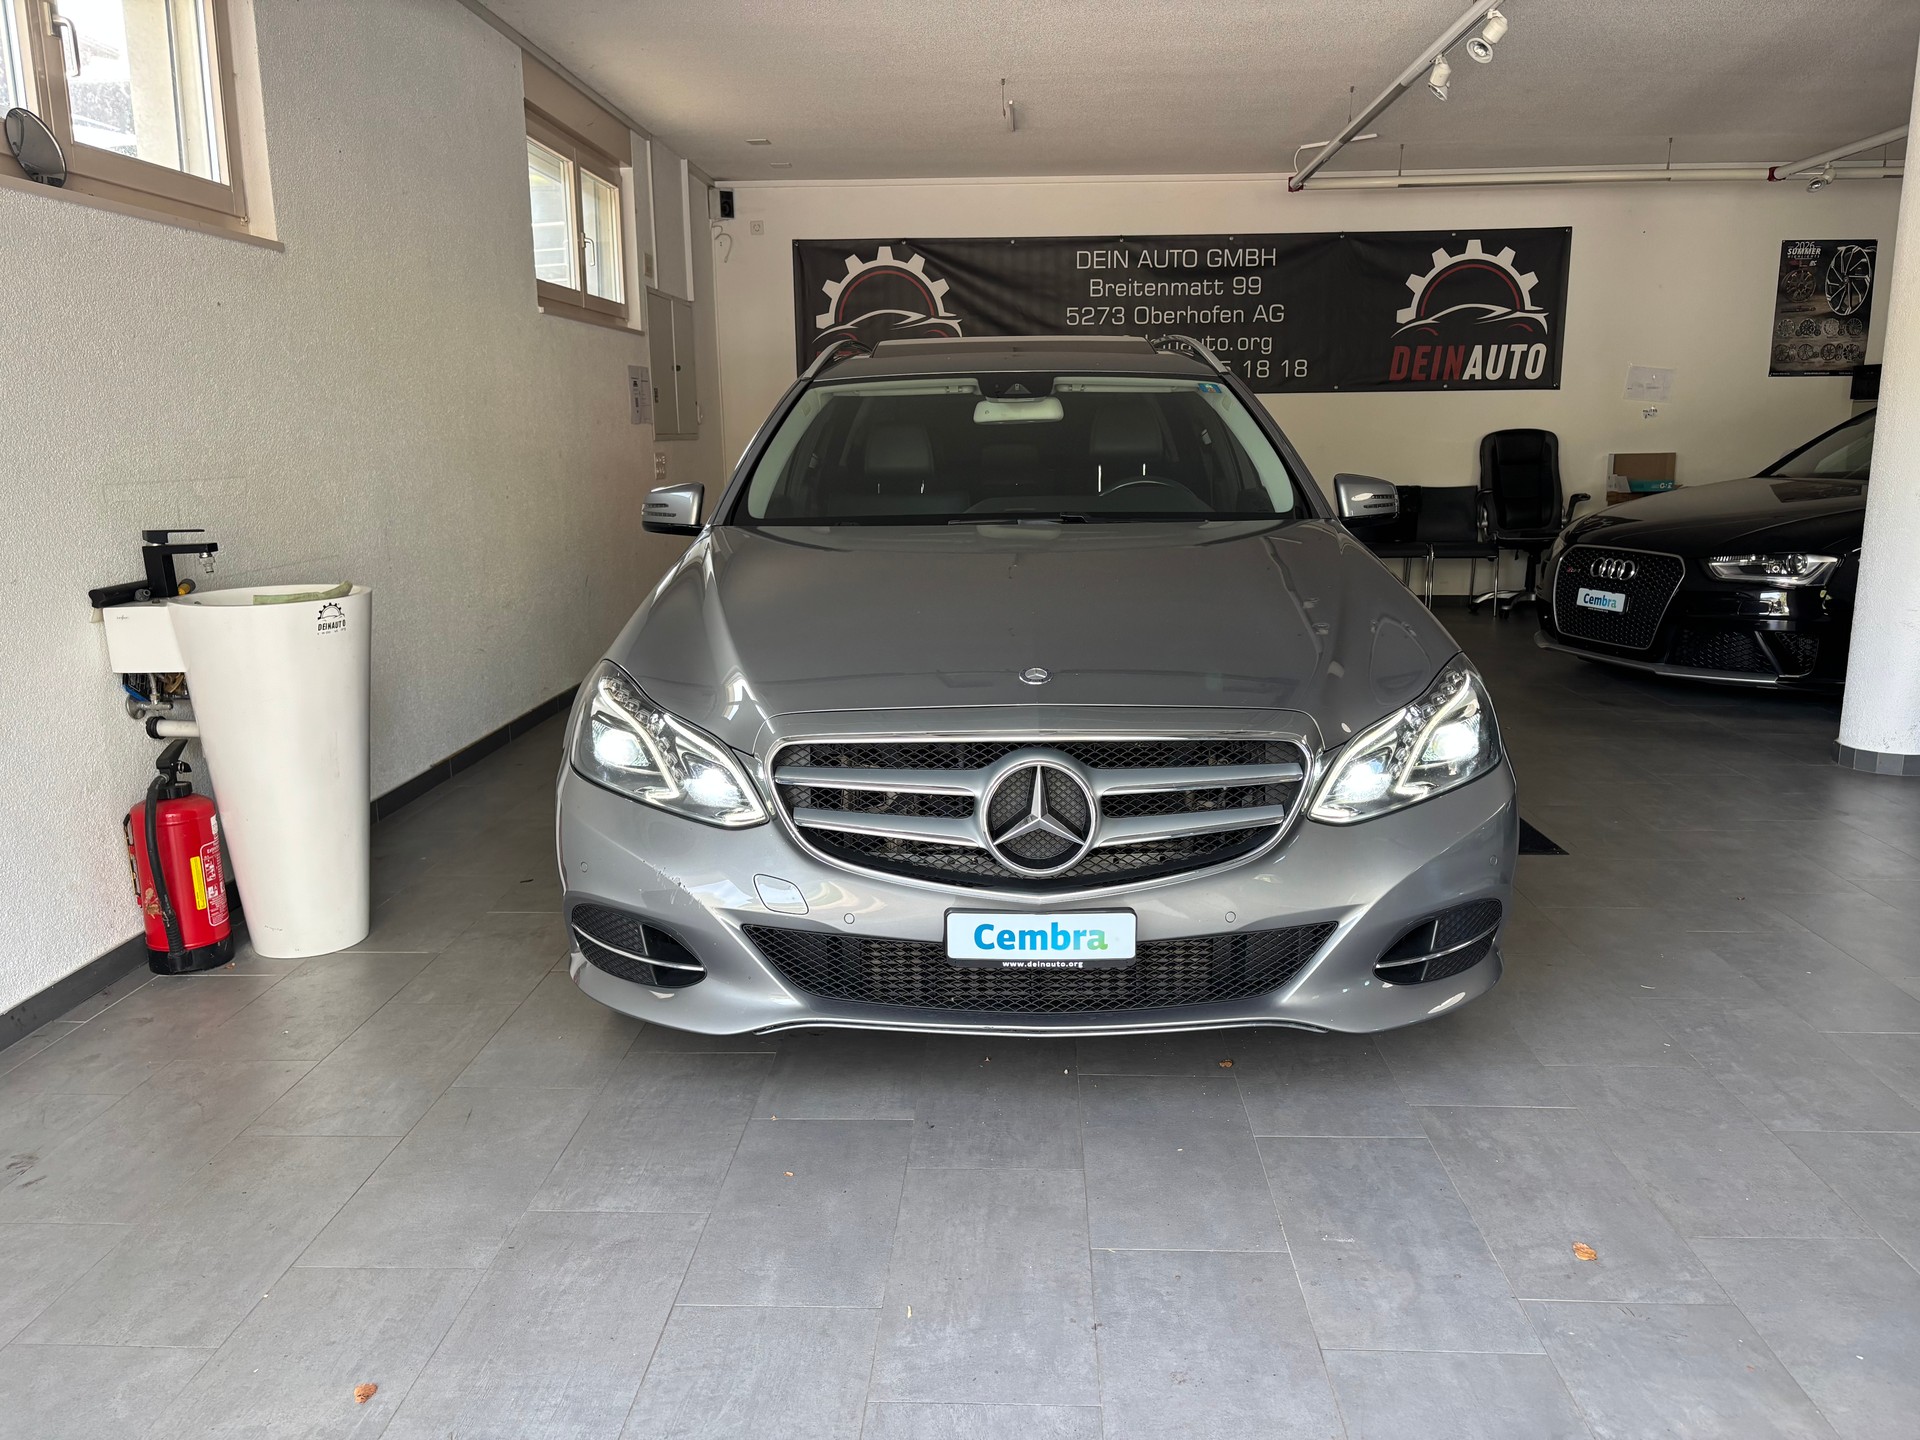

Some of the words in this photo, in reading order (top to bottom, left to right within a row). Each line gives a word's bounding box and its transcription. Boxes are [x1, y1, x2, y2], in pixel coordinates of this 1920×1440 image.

[1076, 250, 1129, 269] DEIN
[1137, 249, 1198, 268] AUTO
[1207, 248, 1276, 267] GMBH
[1089, 278, 1224, 297] Breitenmatt
[1233, 276, 1262, 295] 99
[1066, 306, 1125, 326] 5273
[1134, 305, 1244, 325] Oberhofen
[1252, 304, 1285, 323] AG
[1243, 359, 1270, 378] 18
[1281, 359, 1308, 378] 18
[1389, 342, 1547, 381] DEINAUTO
[1583, 593, 1617, 608] Cembra
[974, 922, 1109, 951] Cembra
[1002, 960, 1084, 969] www.deinauto.org
